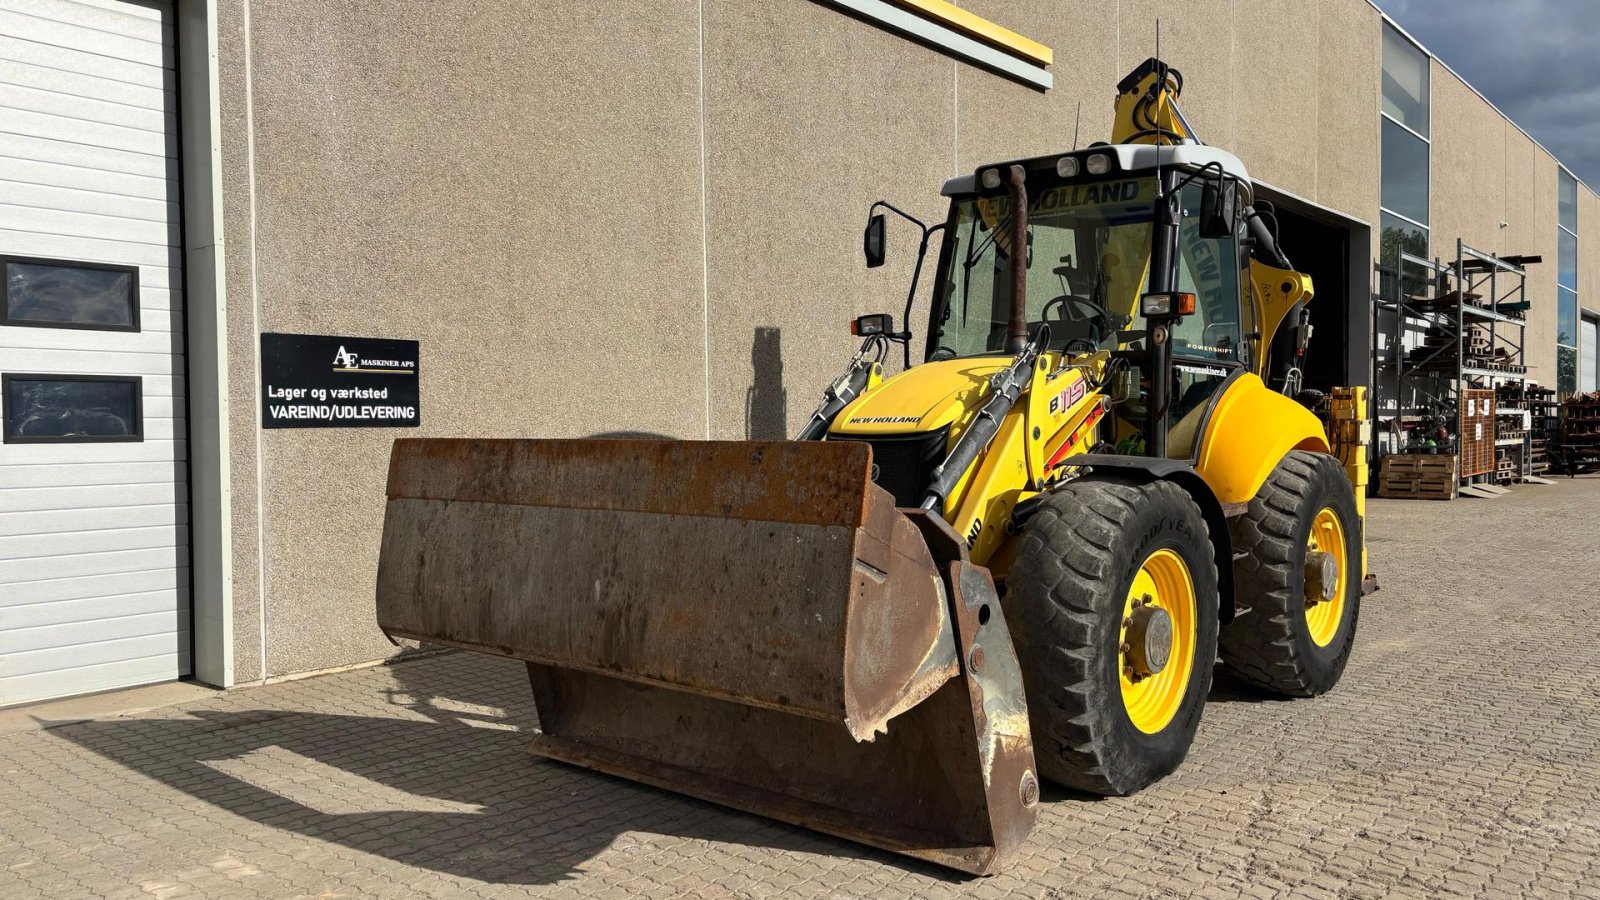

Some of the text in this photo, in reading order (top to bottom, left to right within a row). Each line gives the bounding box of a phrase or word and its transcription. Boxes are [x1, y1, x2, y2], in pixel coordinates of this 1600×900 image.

[1034, 180, 1140, 211] OLLAND
[1187, 343, 1233, 354] POWERSHIFT
[360, 359, 400, 368] MASKINER
[400, 360, 415, 368] APS
[267, 385, 389, 402] Lager og værksted
[269, 404, 416, 421] VAREIND/UDLEVERING
[872, 416, 923, 424] HOLLAND
